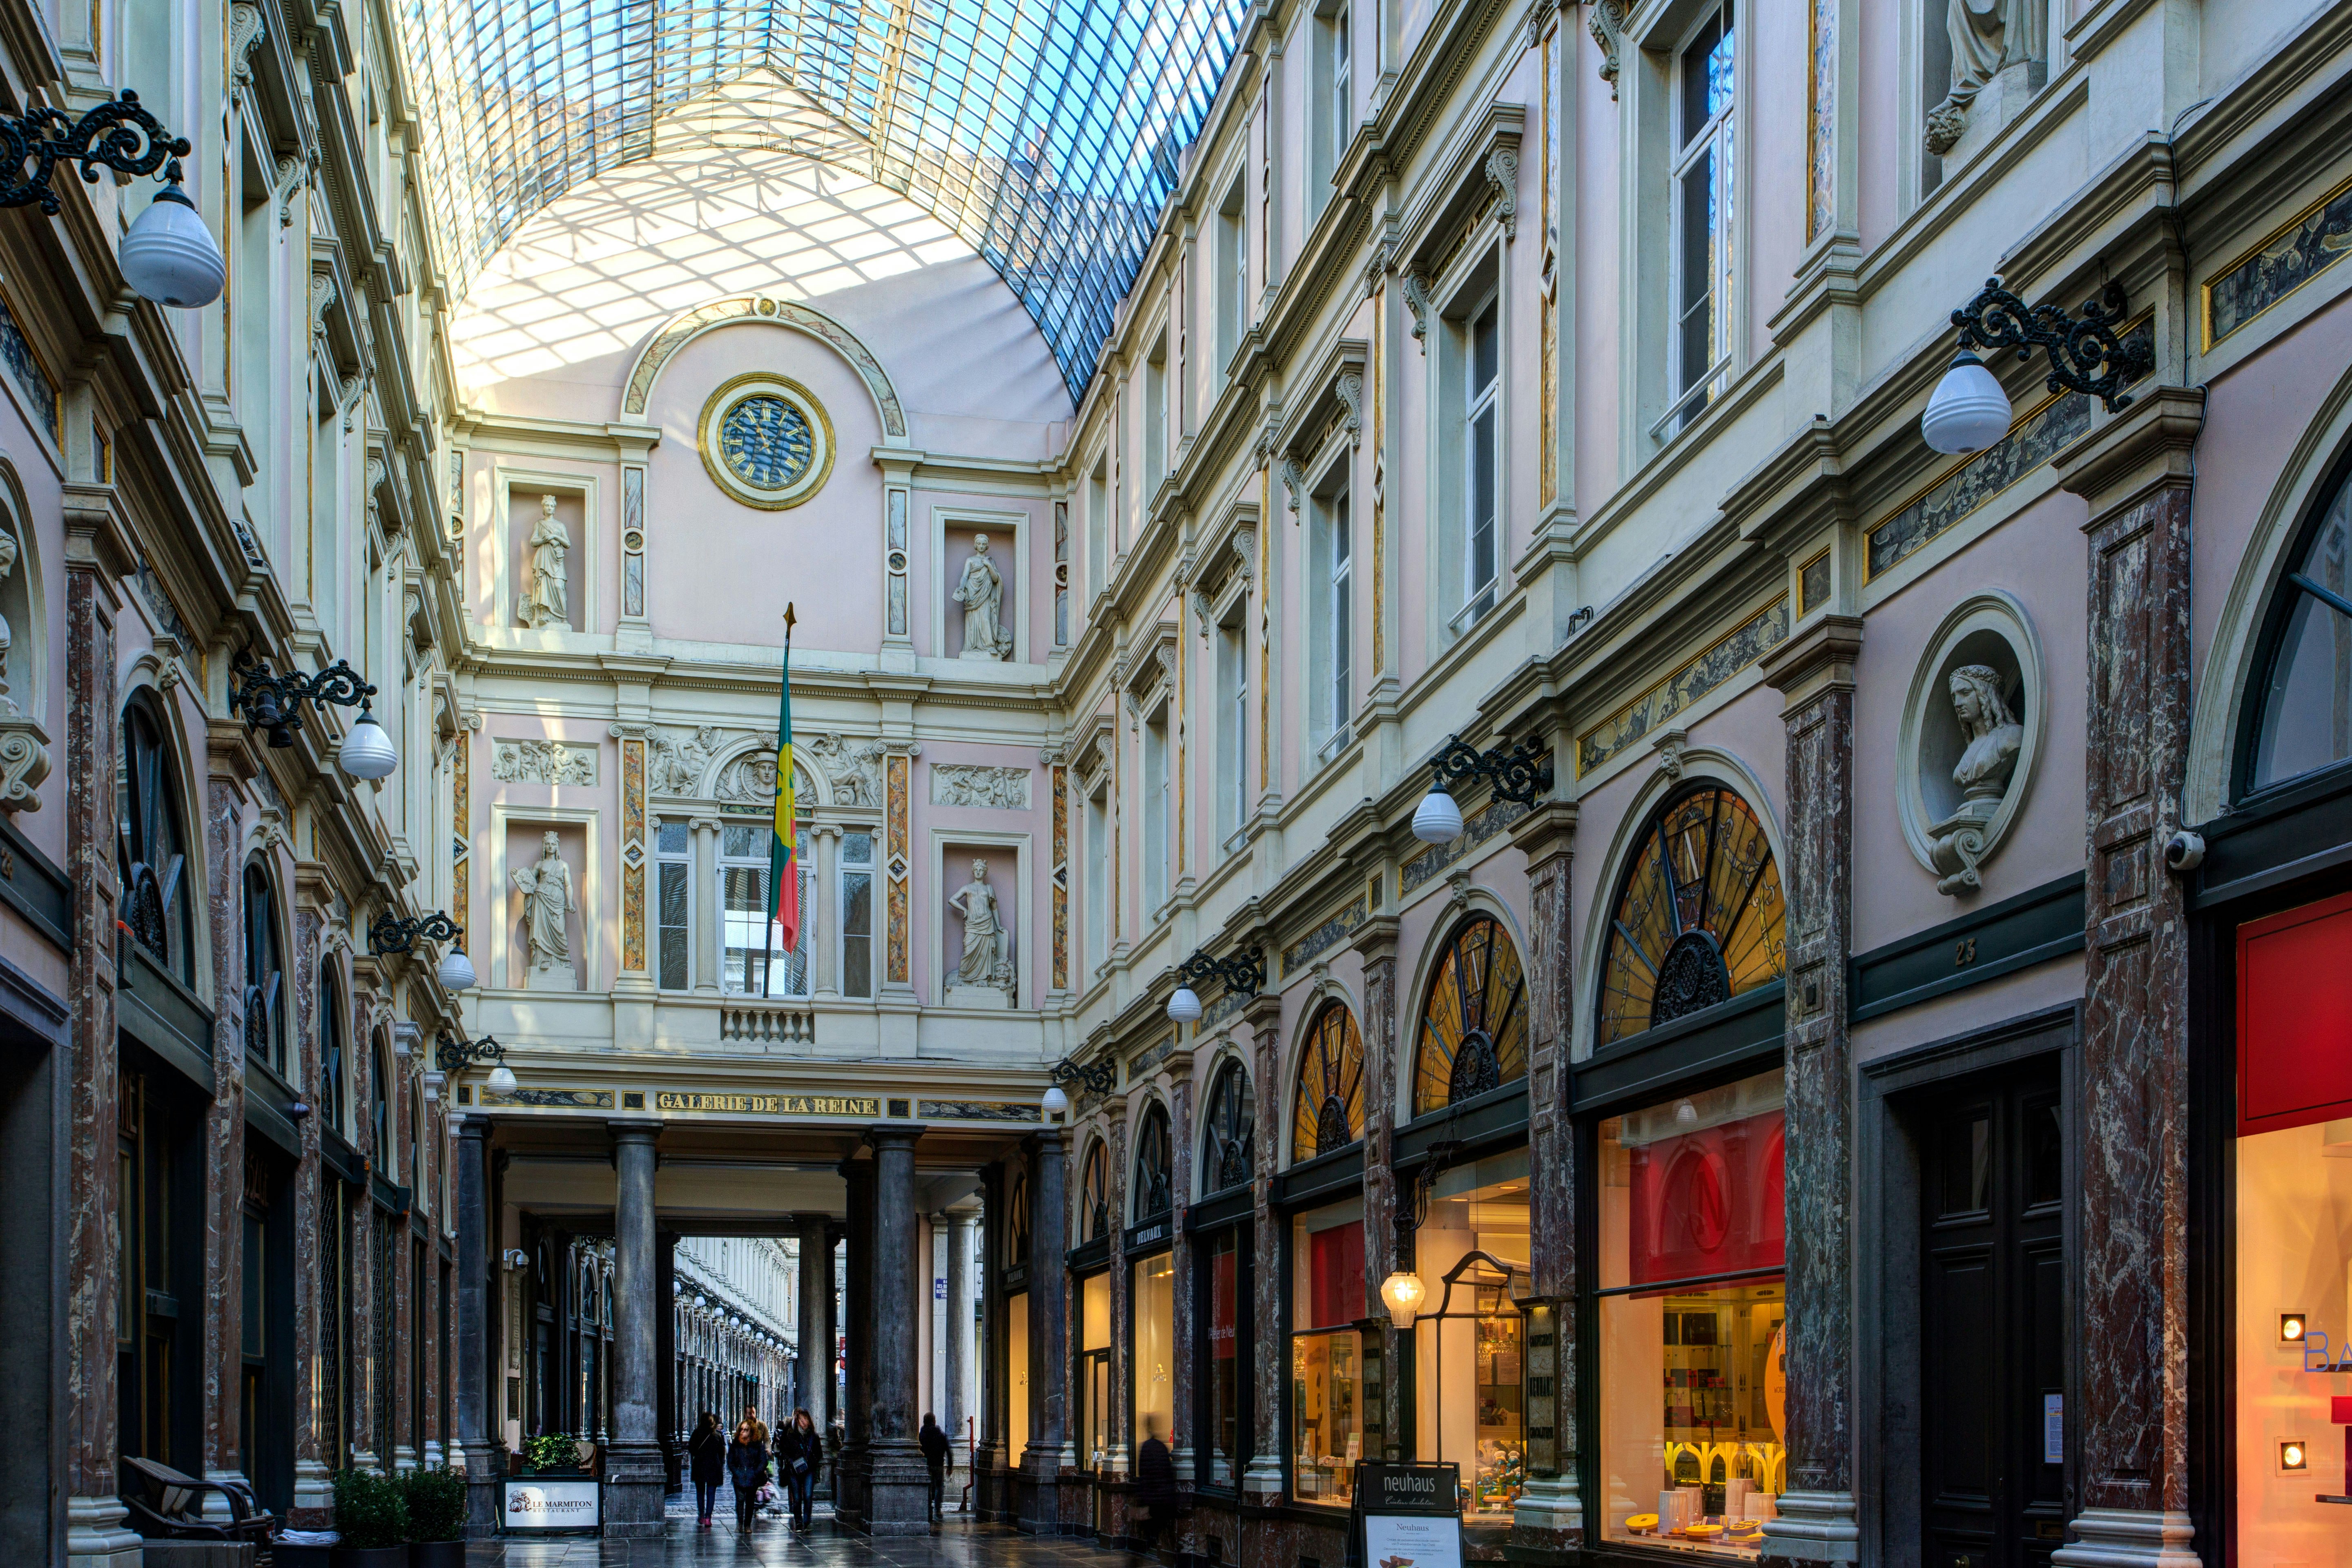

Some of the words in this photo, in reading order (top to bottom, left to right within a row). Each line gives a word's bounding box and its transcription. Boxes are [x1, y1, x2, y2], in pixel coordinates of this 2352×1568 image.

[1955, 937, 1975, 966] 23
[1467, 1058, 1476, 1073] 25
[660, 1093, 746, 1111] GALERIE
[751, 1097, 778, 1112] DE
[783, 1098, 810, 1113] LA
[814, 1099, 876, 1114] REINE.
[1137, 1225, 1161, 1245] DELVAUX
[1221, 1325, 1226, 1338] de
[1384, 1472, 1435, 1492] neuhaus
[1396, 1523, 1429, 1531] Neuhaus
